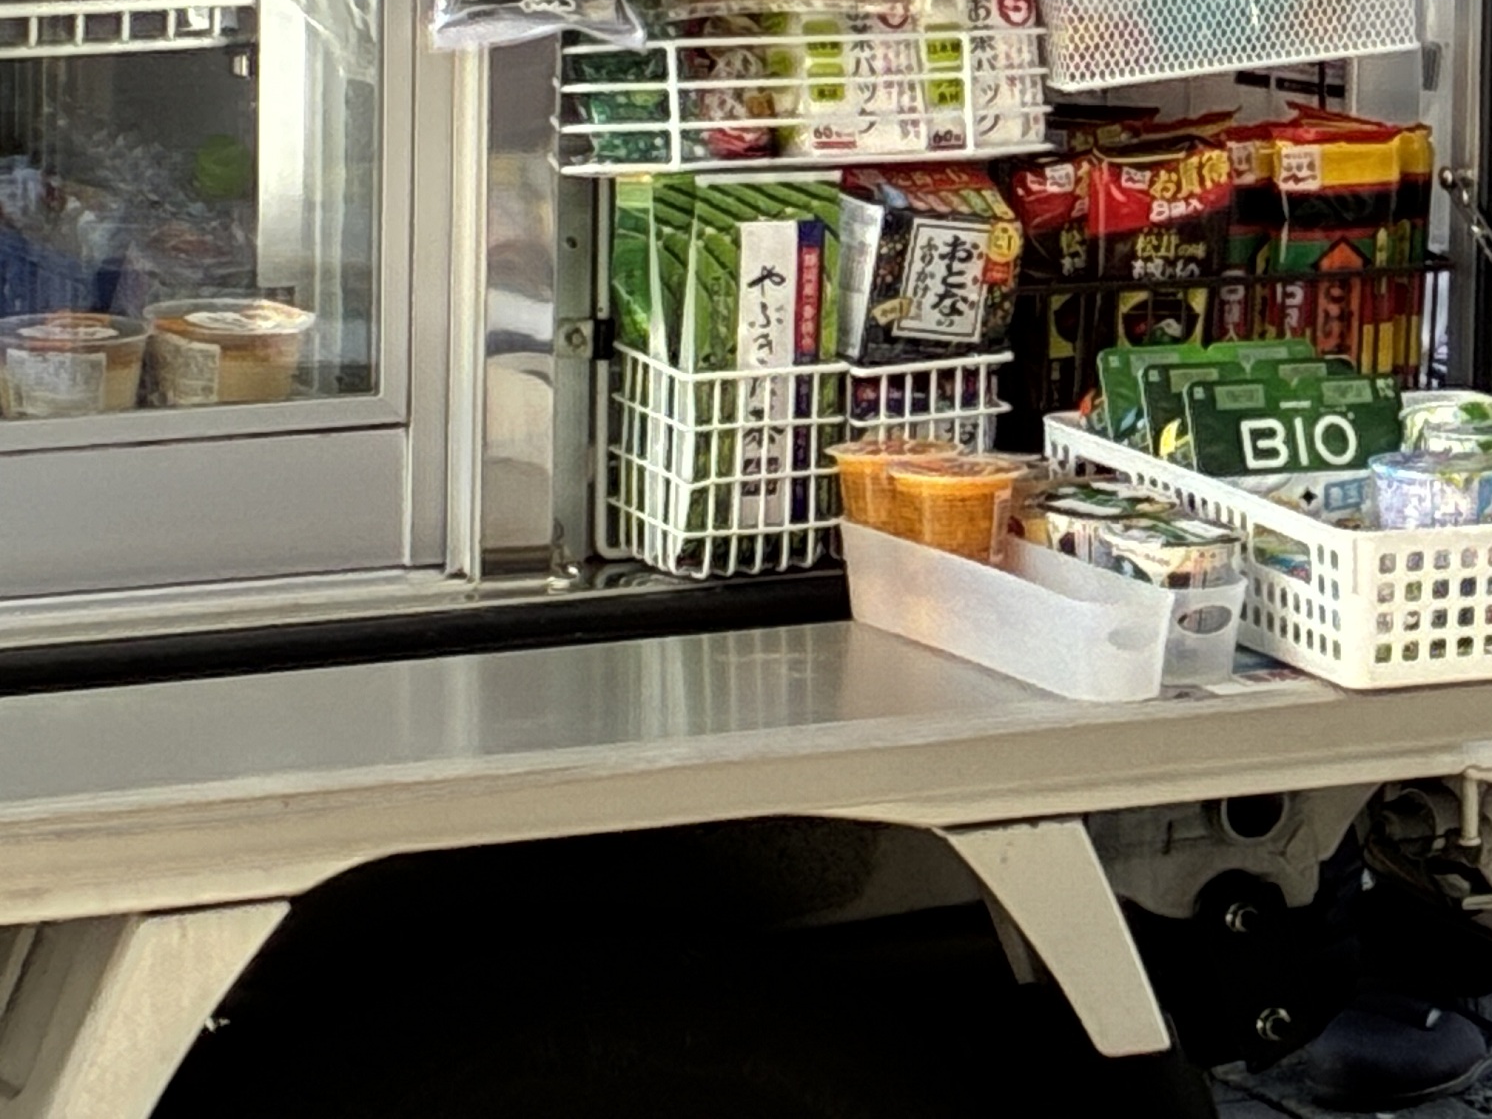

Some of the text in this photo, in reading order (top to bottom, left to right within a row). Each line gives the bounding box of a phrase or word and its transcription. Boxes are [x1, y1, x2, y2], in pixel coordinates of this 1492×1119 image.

[911, 237, 940, 300] ふりかけ
[930, 234, 985, 327] おとなの
[1240, 414, 1358, 470] BIO
